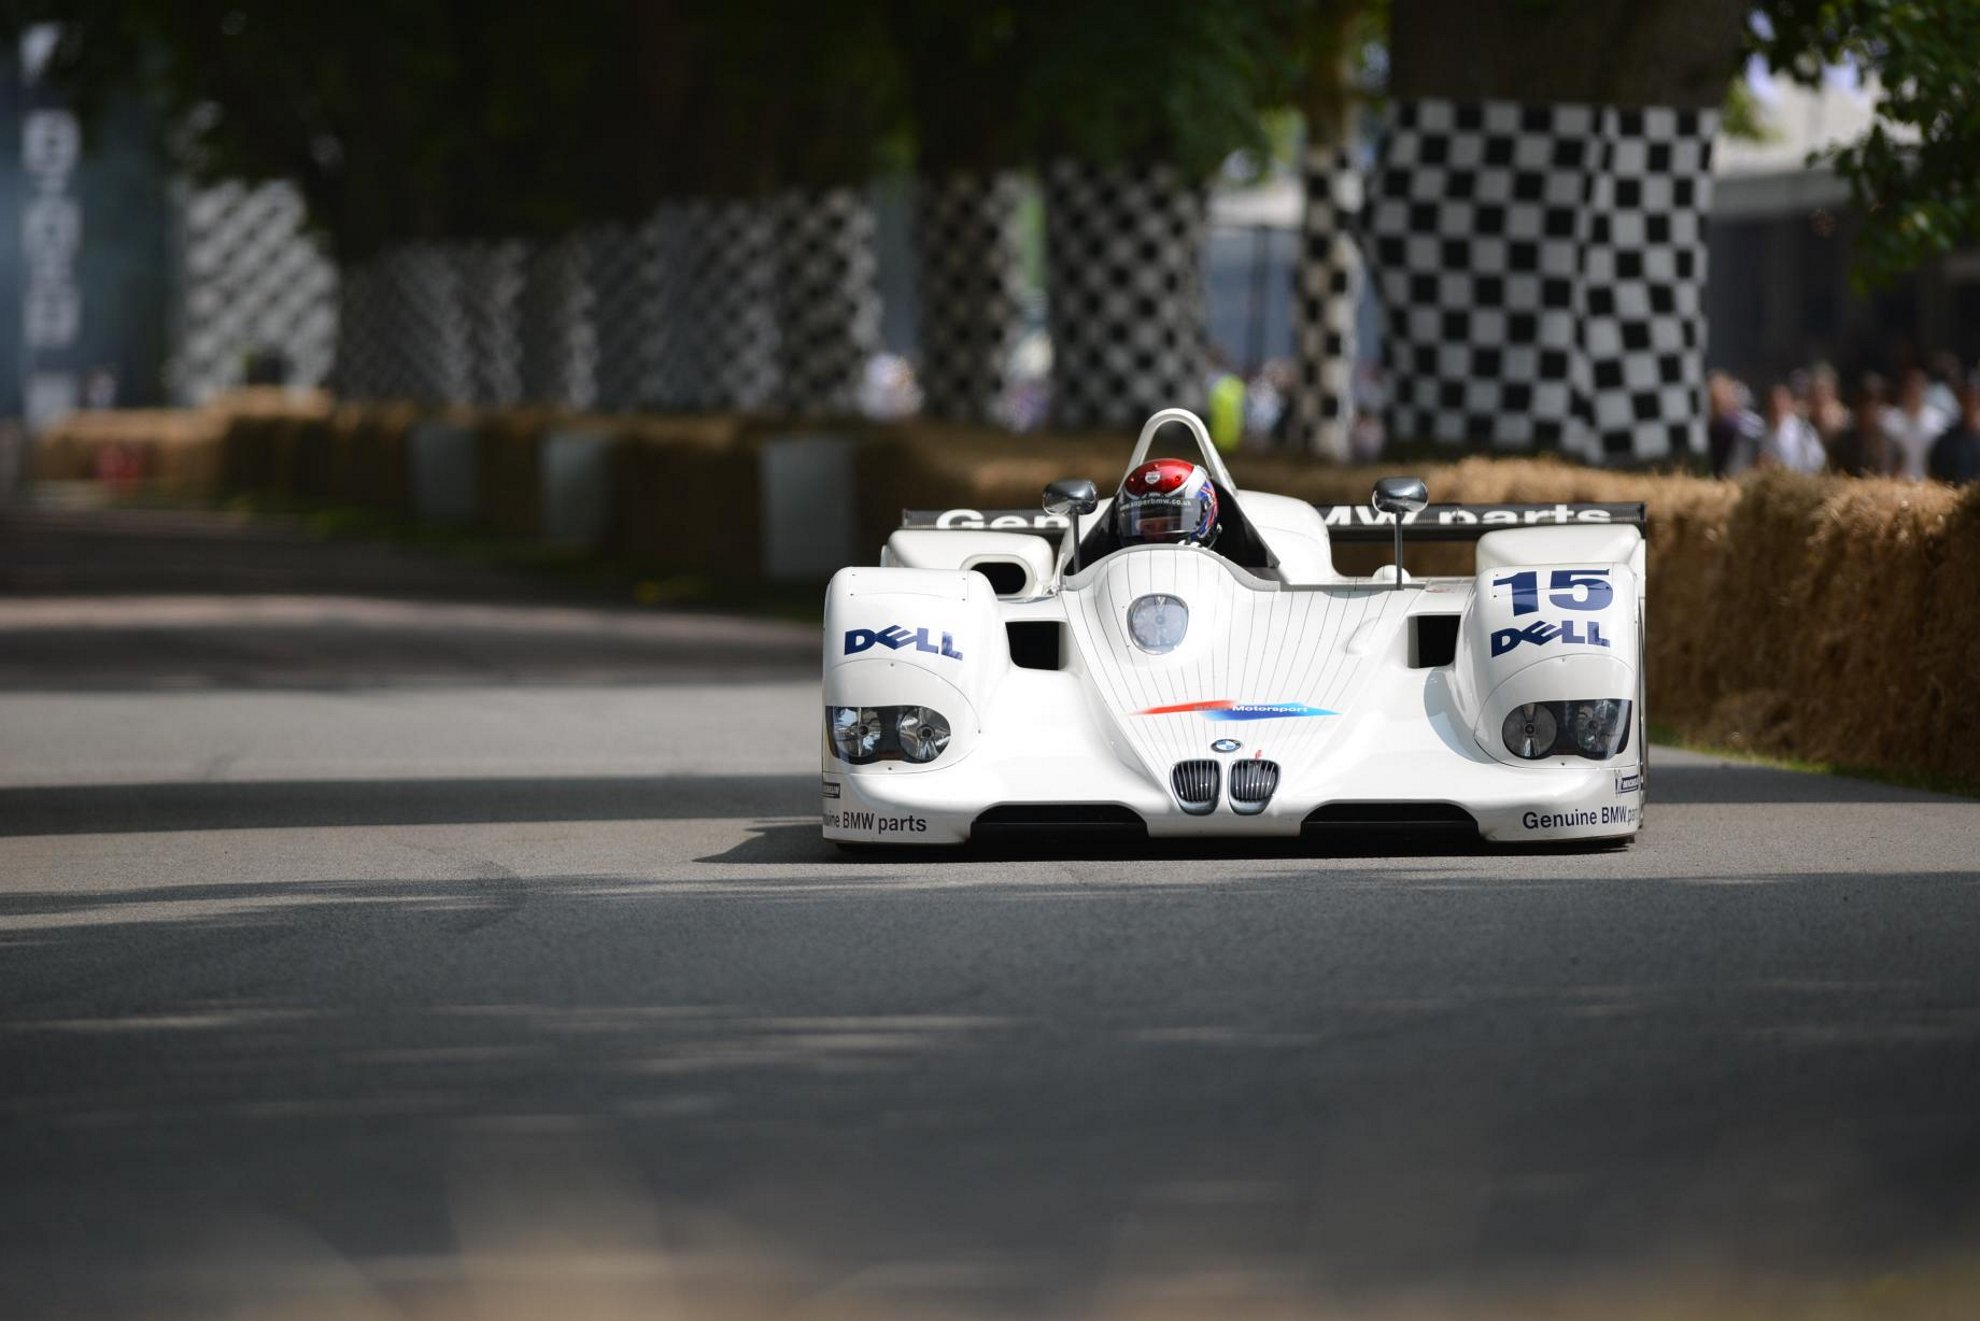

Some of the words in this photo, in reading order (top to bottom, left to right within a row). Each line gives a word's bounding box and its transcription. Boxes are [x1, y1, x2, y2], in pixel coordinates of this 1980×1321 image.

[1493, 569, 1614, 617] 15
[843, 625, 963, 661] DELL
[1490, 620, 1611, 658] DELL
[1231, 705, 1308, 713] Motorsport
[842, 811, 875, 830] BMW
[878, 815, 928, 835] parts
[1522, 808, 1598, 830] Genuine
[1601, 805, 1628, 825] BMW
